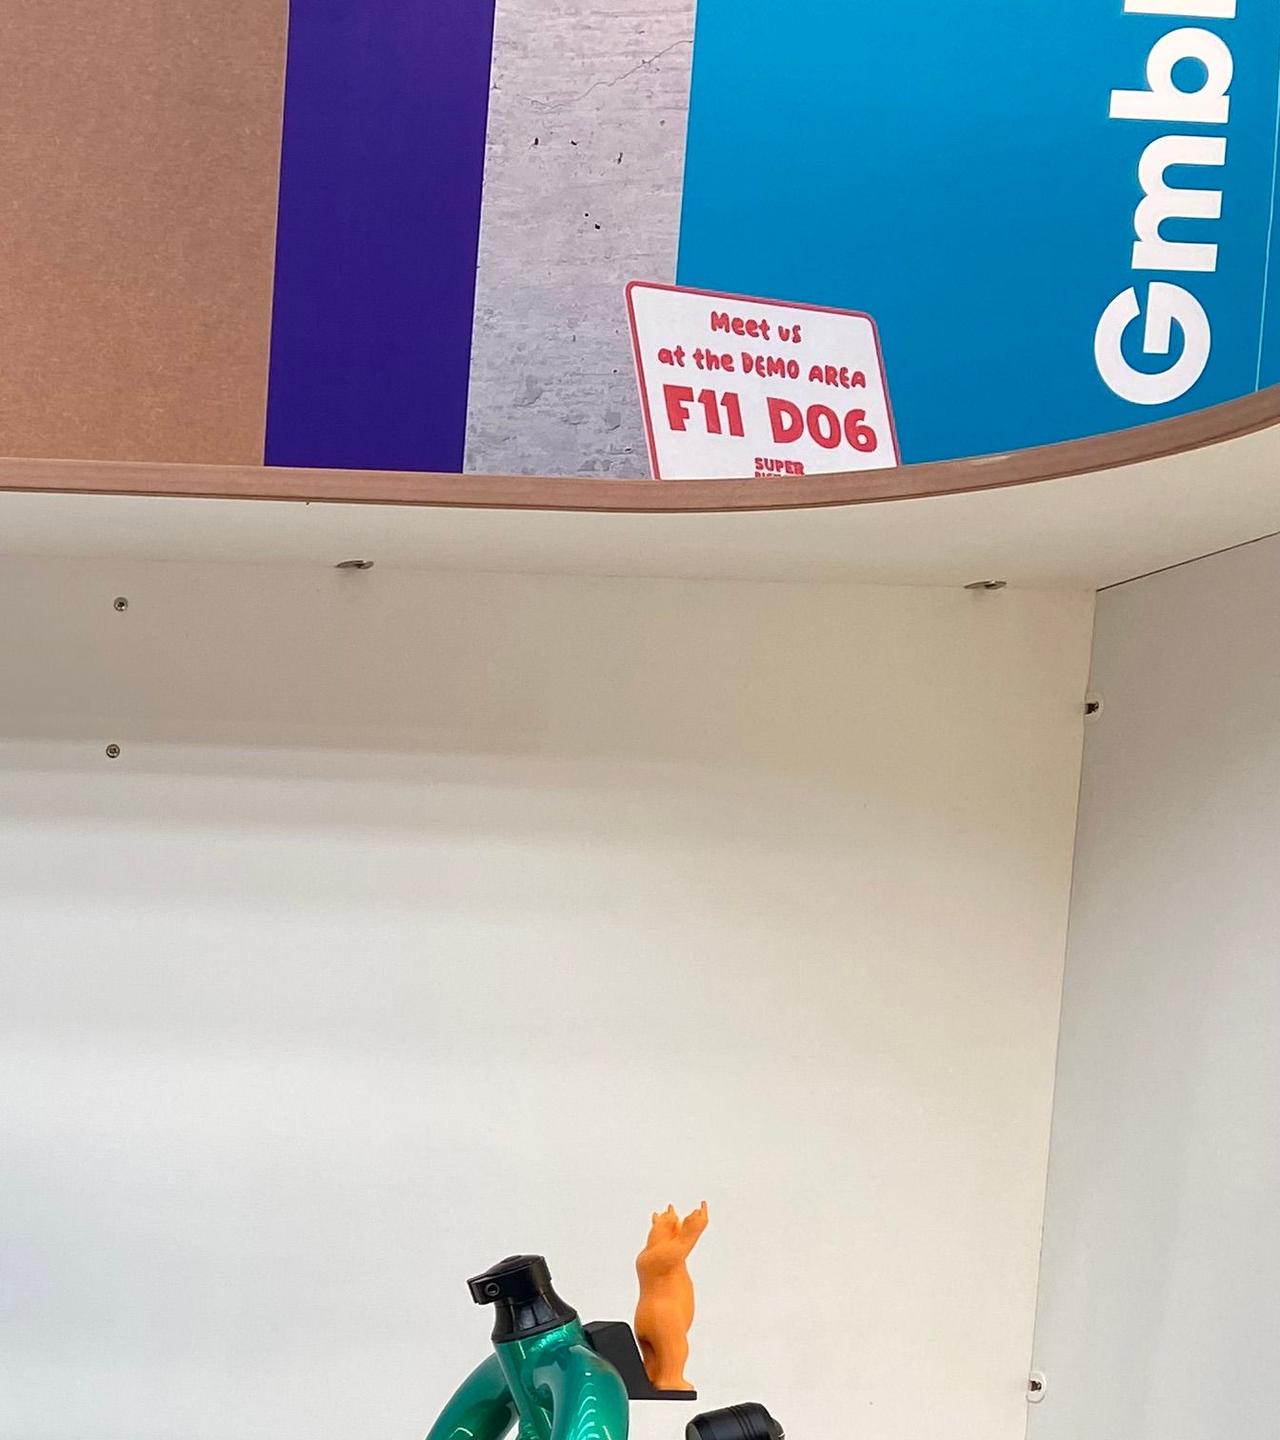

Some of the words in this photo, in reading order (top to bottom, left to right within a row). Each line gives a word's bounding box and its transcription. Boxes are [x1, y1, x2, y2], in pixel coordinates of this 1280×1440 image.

[710, 311, 770, 340] Meet
[778, 324, 802, 343] us
[658, 345, 685, 367] at
[692, 348, 735, 373] the
[741, 352, 800, 379] DEMO
[808, 365, 866, 389] AREA
[663, 384, 744, 437] F11
[754, 457, 805, 475] SUPER
